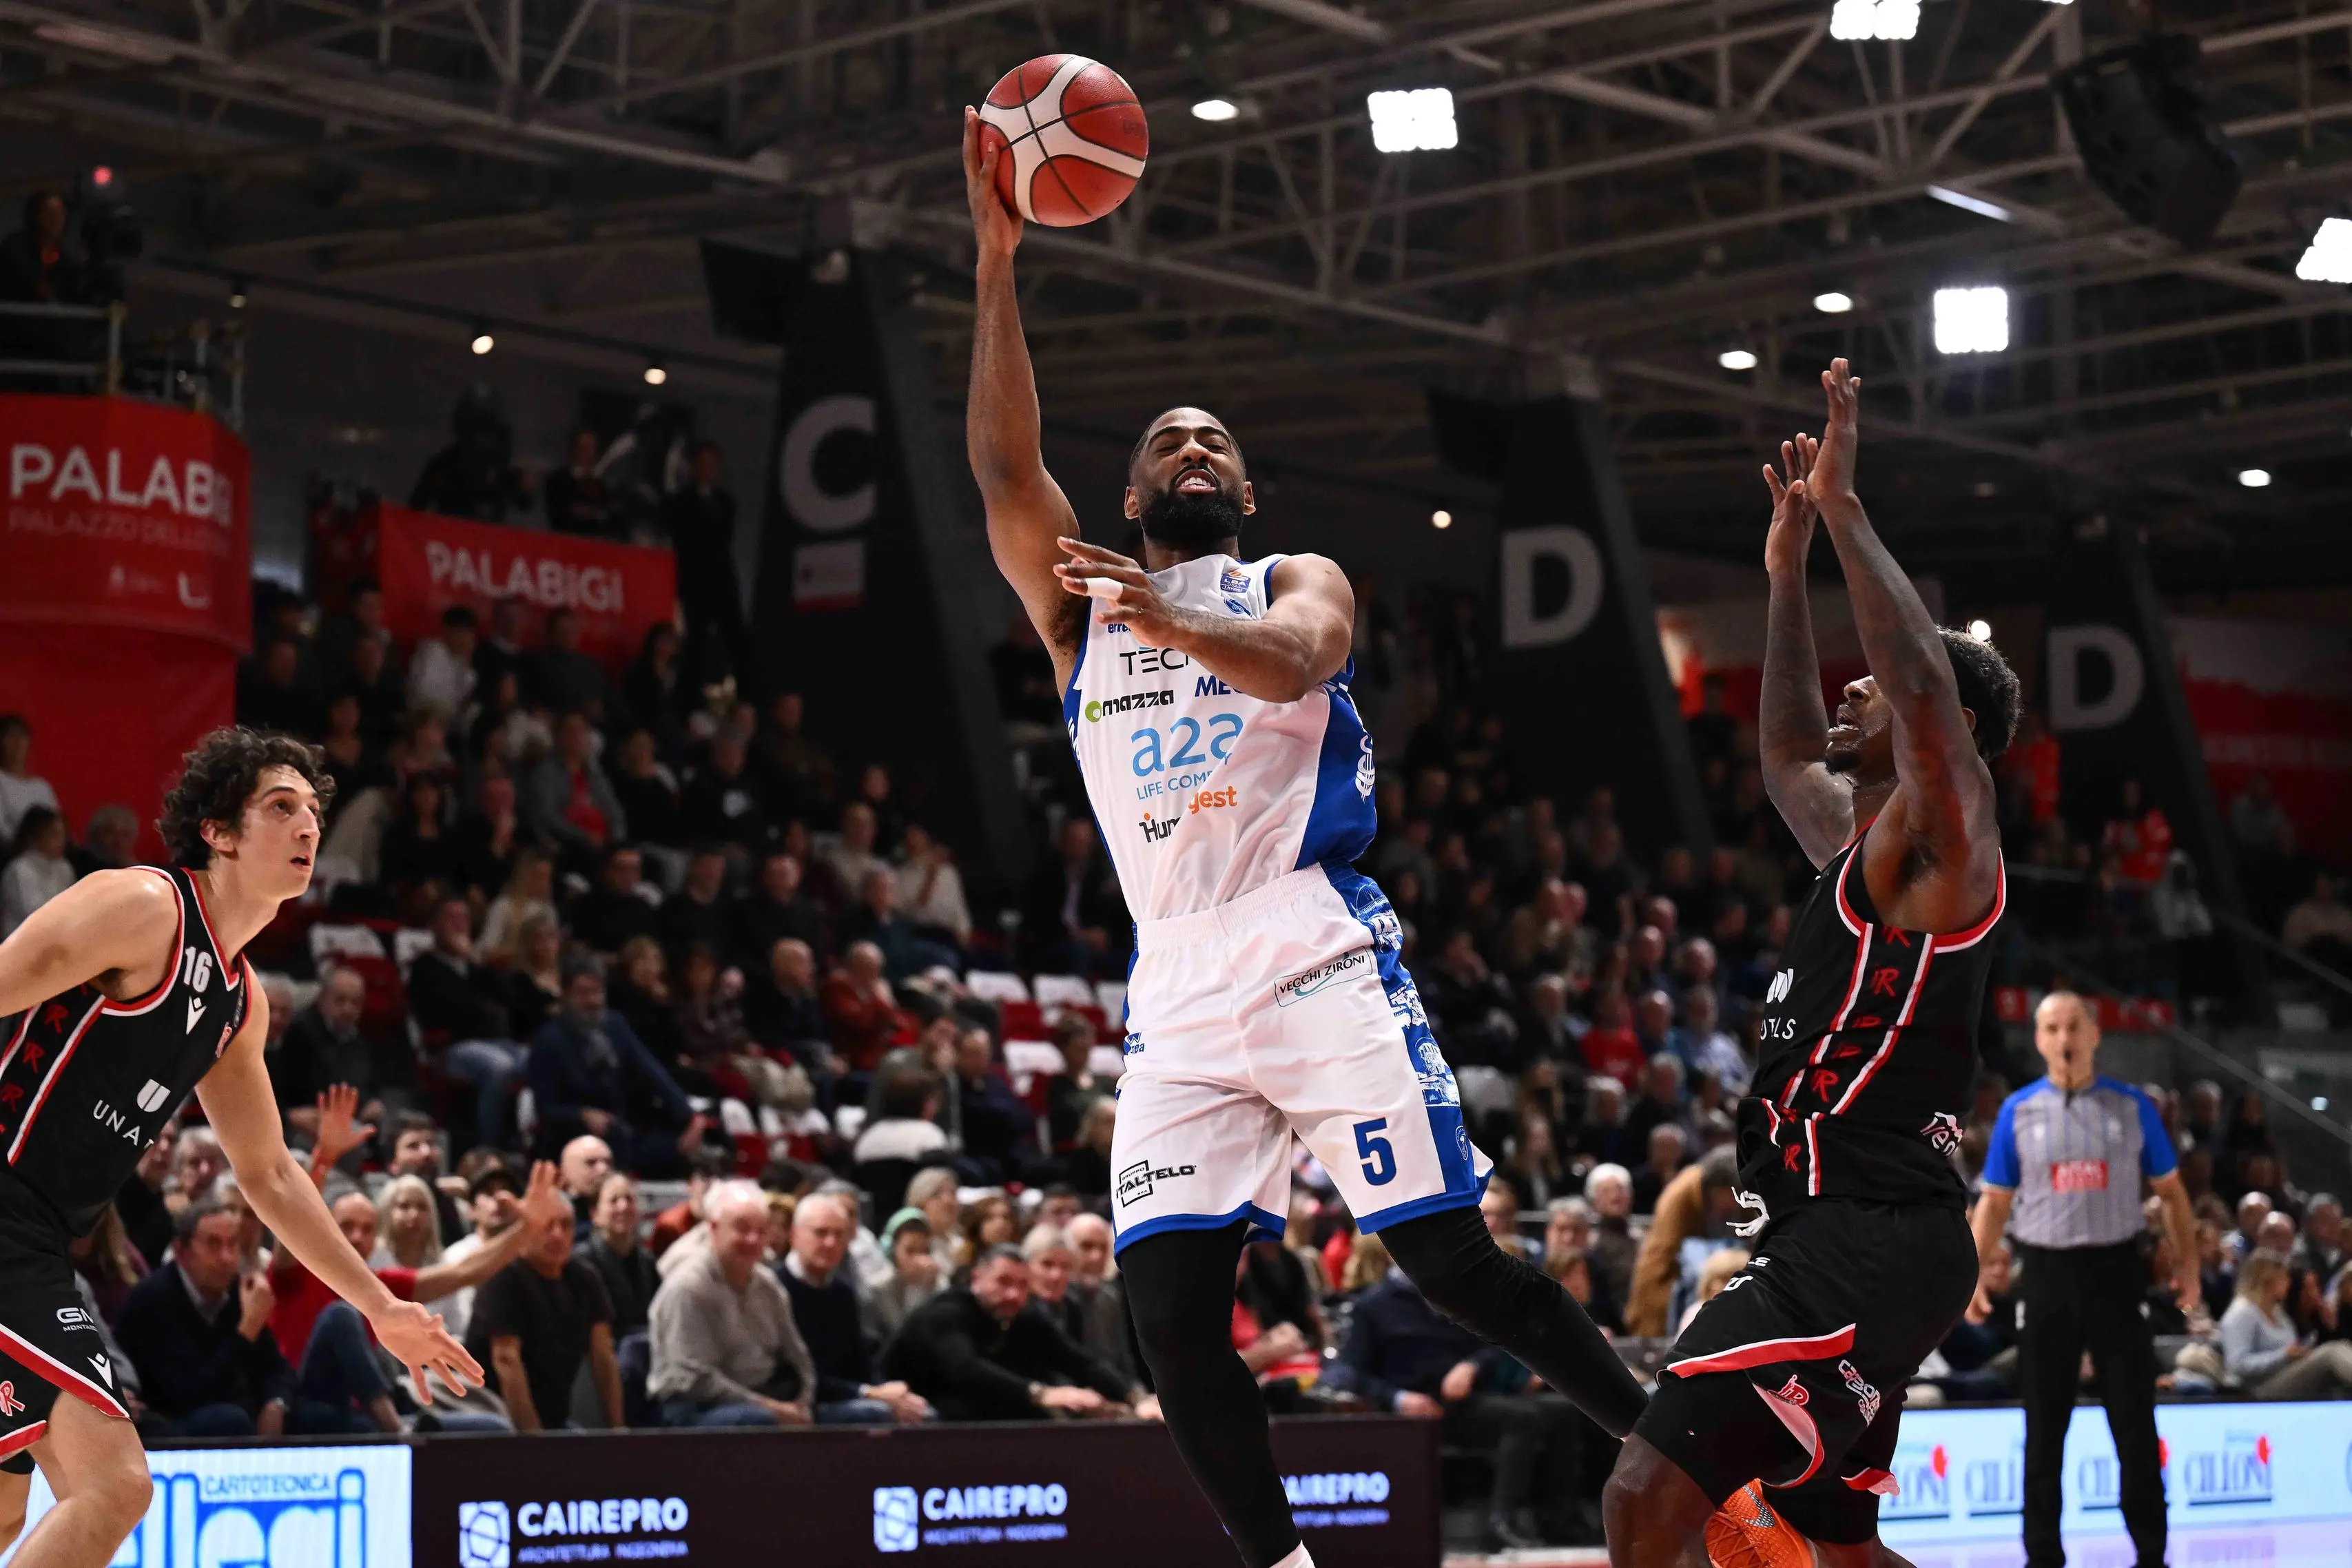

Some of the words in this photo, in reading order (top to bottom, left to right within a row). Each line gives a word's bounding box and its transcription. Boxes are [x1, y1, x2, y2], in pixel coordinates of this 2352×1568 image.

[781, 395, 878, 532] C
[425, 541, 623, 612] PALABIGI
[1502, 525, 1605, 648] D
[1108, 623, 1131, 633] erre
[1195, 675, 1243, 697] ME
[2047, 624, 2144, 730] D
[1131, 713, 1244, 777] a2a
[1137, 781, 1164, 800] LIFE
[183, 946, 213, 993] 16
[1279, 969, 1321, 993] VECCHI
[1325, 955, 1365, 976] ZIRONI
[1352, 1117, 1397, 1186] 5
[922, 1483, 1067, 1520] CAIREPRO
[1279, 1471, 1390, 1505] AIREPRO
[517, 1497, 688, 1537] CAIREPRO
